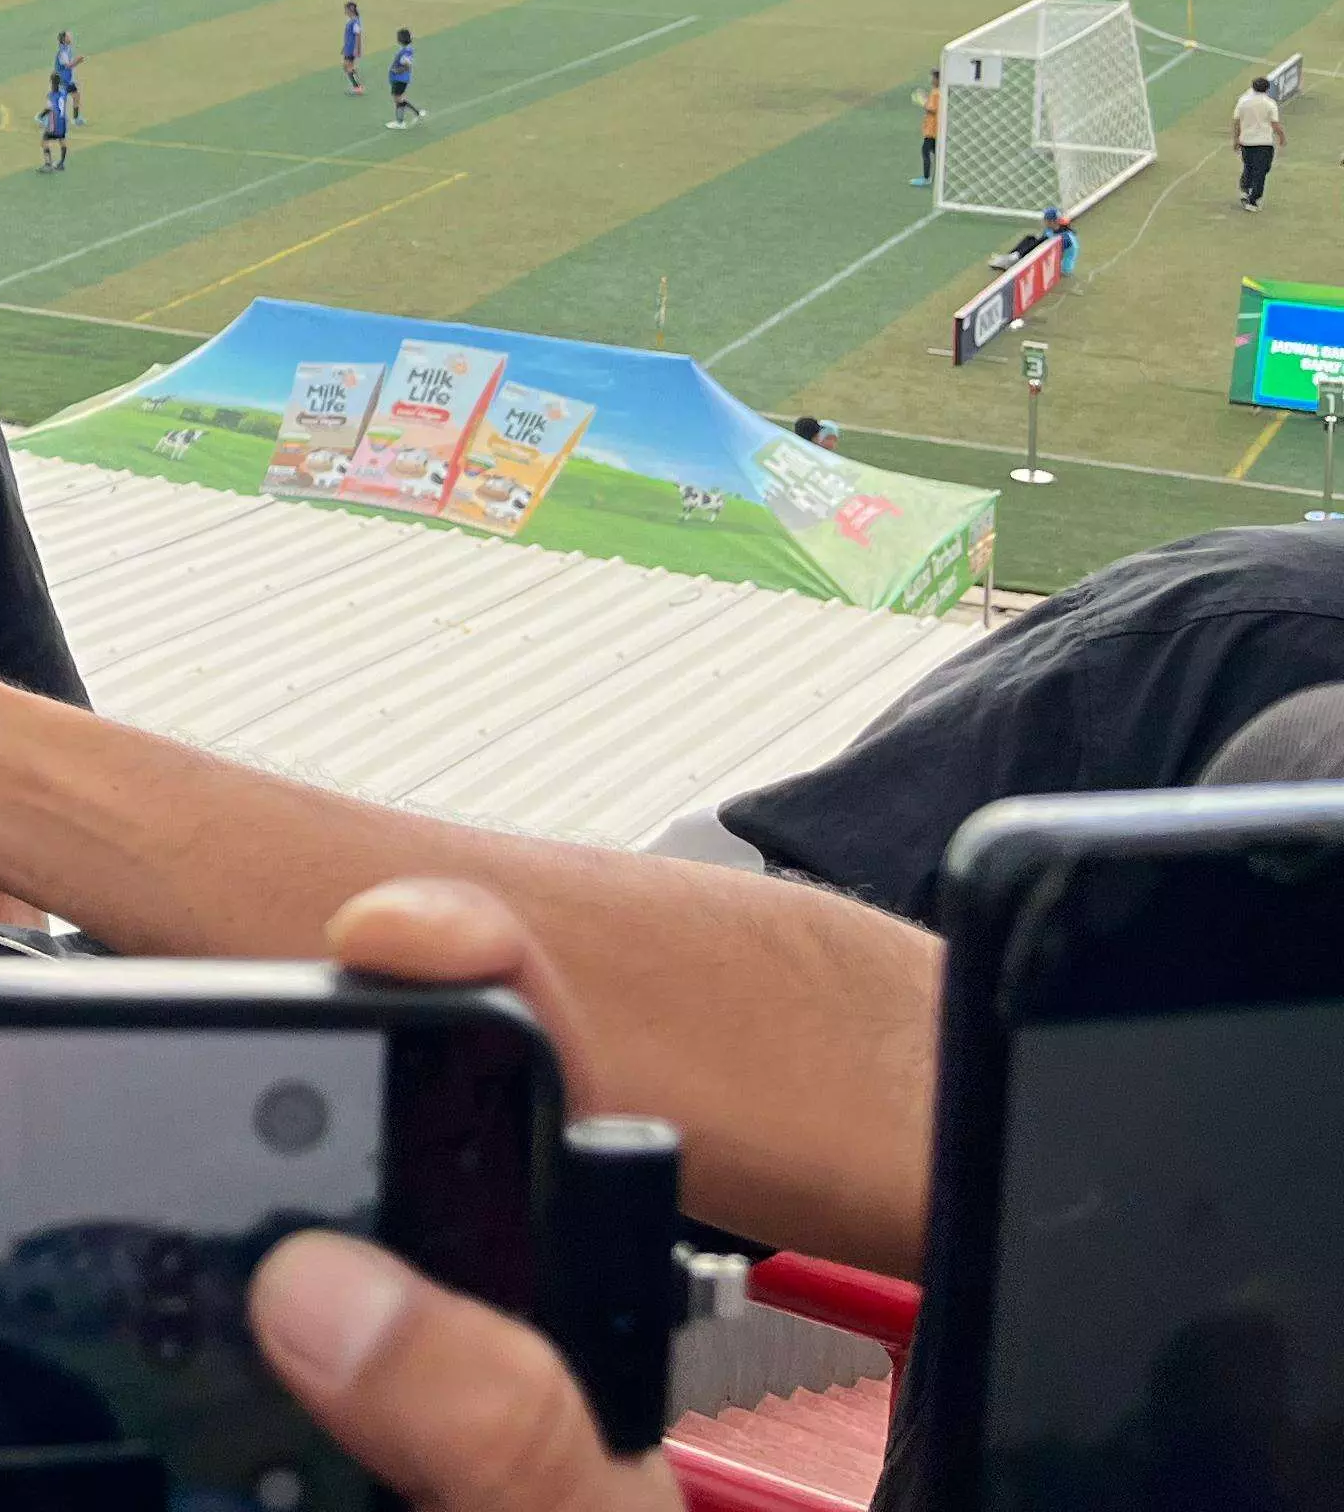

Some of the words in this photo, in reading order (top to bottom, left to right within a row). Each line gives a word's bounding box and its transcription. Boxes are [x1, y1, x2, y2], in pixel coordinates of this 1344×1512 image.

[970, 59, 981, 82] 1
[407, 367, 453, 387] Milk
[1026, 356, 1043, 378] 3
[306, 384, 346, 399] Milk
